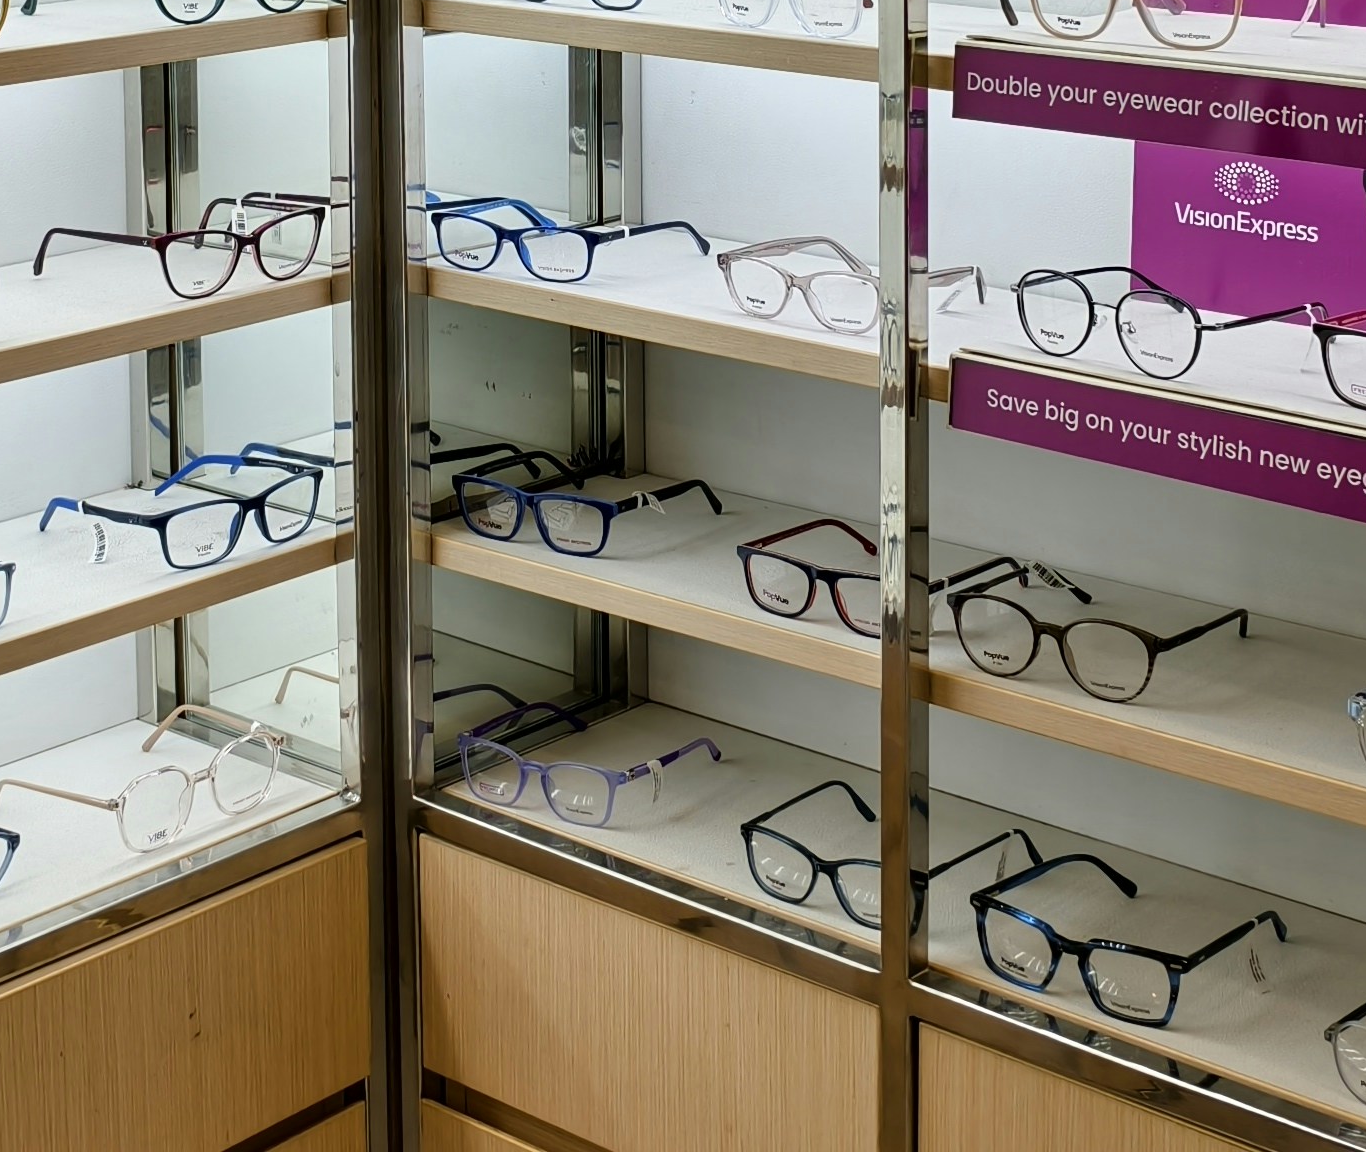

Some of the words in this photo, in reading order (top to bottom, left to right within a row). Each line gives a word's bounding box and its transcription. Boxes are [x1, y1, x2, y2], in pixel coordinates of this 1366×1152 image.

[967, 71, 1042, 98] Double
[1048, 83, 1097, 106] your
[1103, 89, 1203, 115] eyewear
[1208, 99, 1329, 132] collection
[1175, 201, 1318, 242] VisionExpress
[987, 388, 1039, 416] Save
[1045, 399, 1079, 431] big
[1085, 413, 1113, 433] on
[1120, 419, 1171, 443] your
[1177, 431, 1252, 463] stylish
[1259, 449, 1310, 475] new
[762, 588, 789, 605] PopVue
